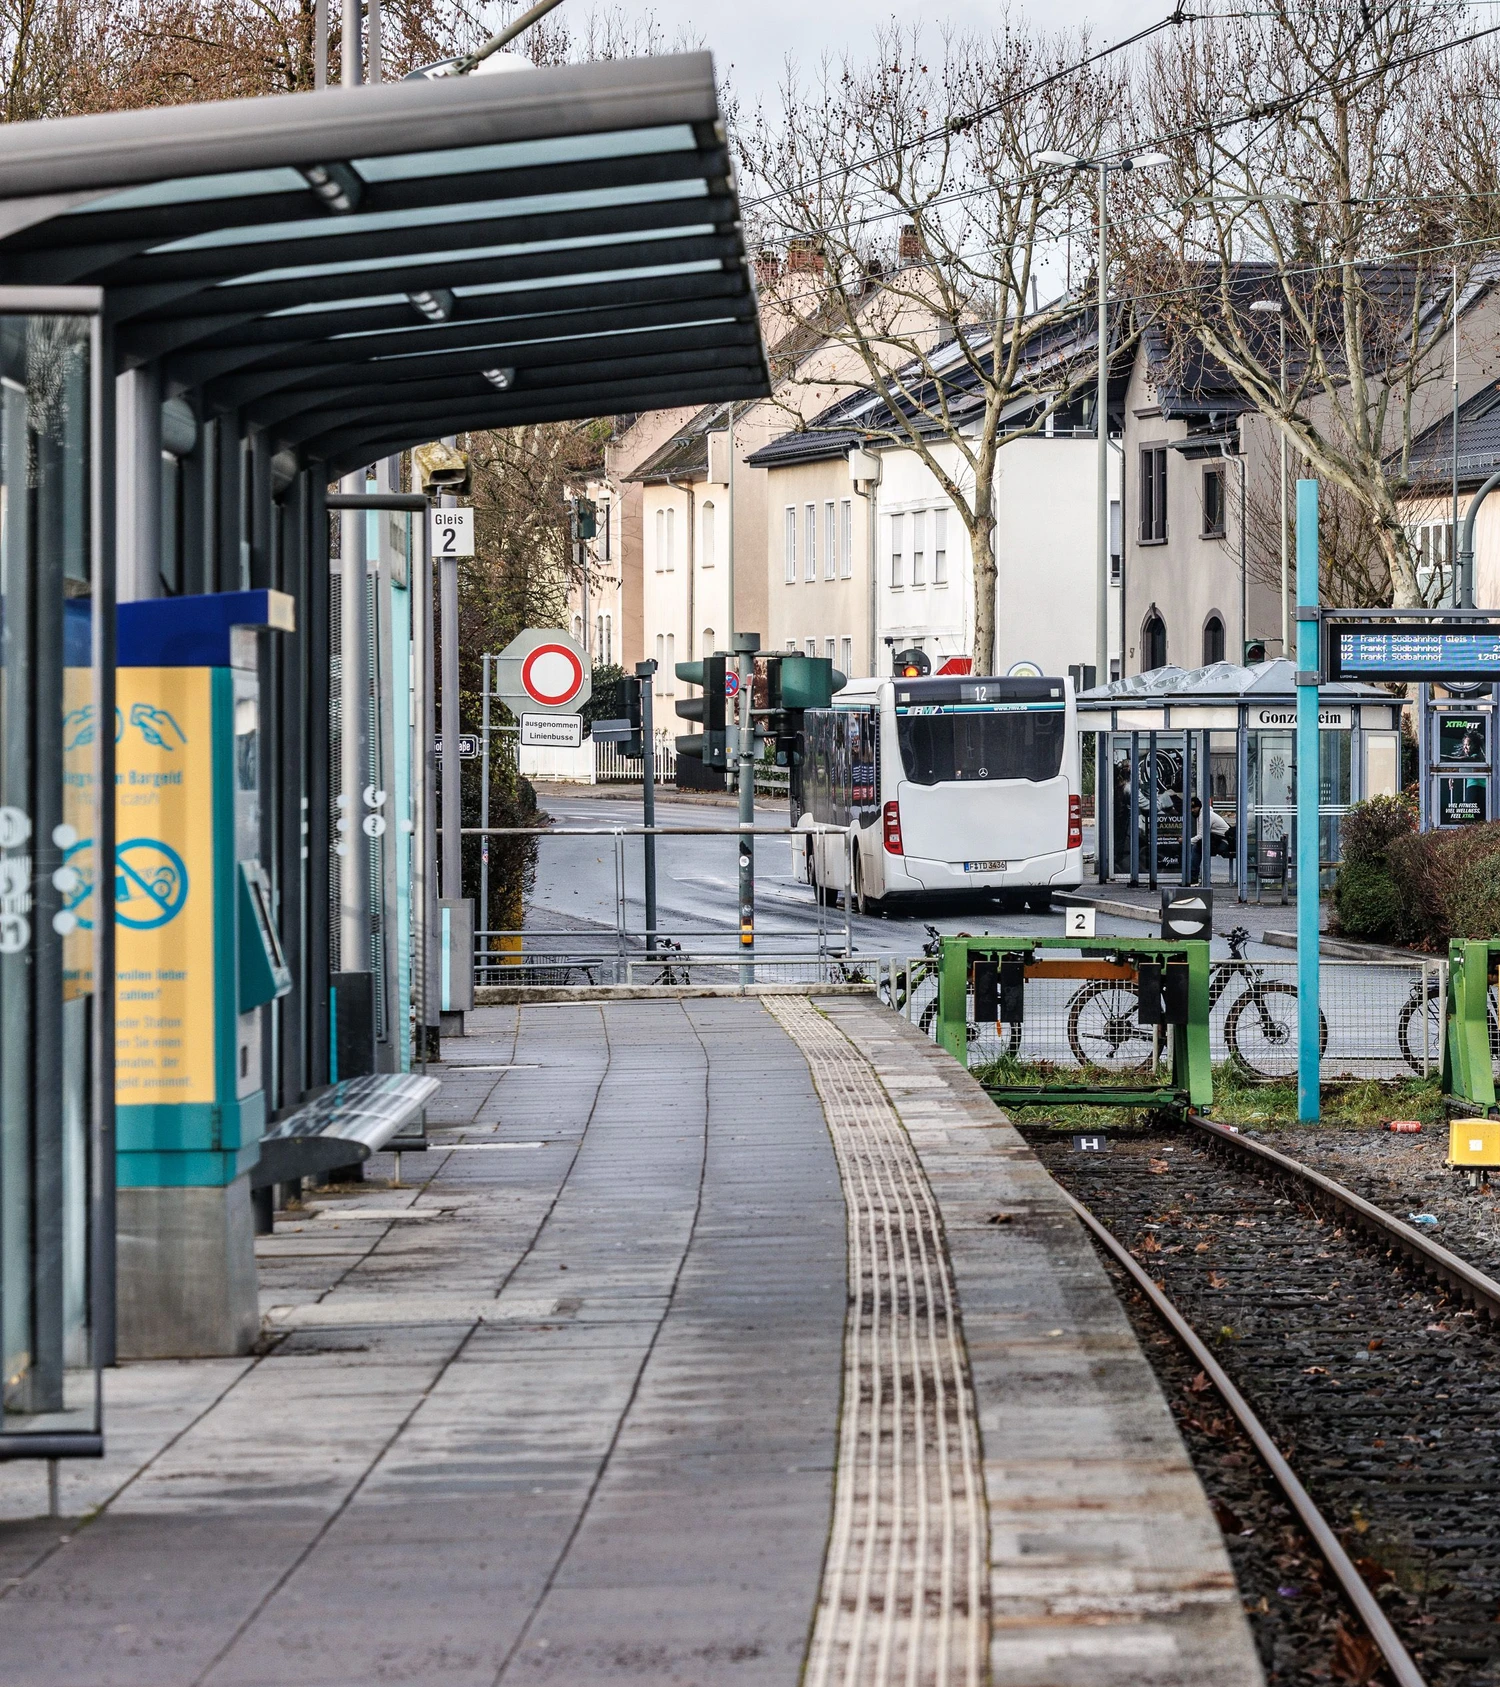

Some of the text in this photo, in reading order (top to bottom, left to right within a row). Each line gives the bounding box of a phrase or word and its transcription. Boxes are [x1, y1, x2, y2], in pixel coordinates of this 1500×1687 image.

[434, 513, 464, 526] Gleis
[442, 528, 457, 552] 2
[1340, 634, 1354, 643] U2
[1360, 634, 1388, 644] Frankf.
[1391, 634, 1442, 644] Südbahnhof
[1445, 634, 1468, 643] Gleis
[1340, 644, 1354, 652] U2
[1360, 644, 1388, 653] Frankf.
[1391, 644, 1442, 653] Südbahnhof
[1340, 653, 1354, 661] U2
[1360, 653, 1388, 662] Frankf.
[1391, 653, 1442, 662] Südbahnhof
[974, 686, 988, 702] 12
[1259, 710, 1342, 724] Gonzeim
[525, 720, 579, 731] ausgenommen
[1445, 720, 1481, 729] XTRAFIT
[529, 732, 574, 742] Linienbusse
[1075, 913, 1086, 930] 2
[1080, 1138, 1099, 1150] H
